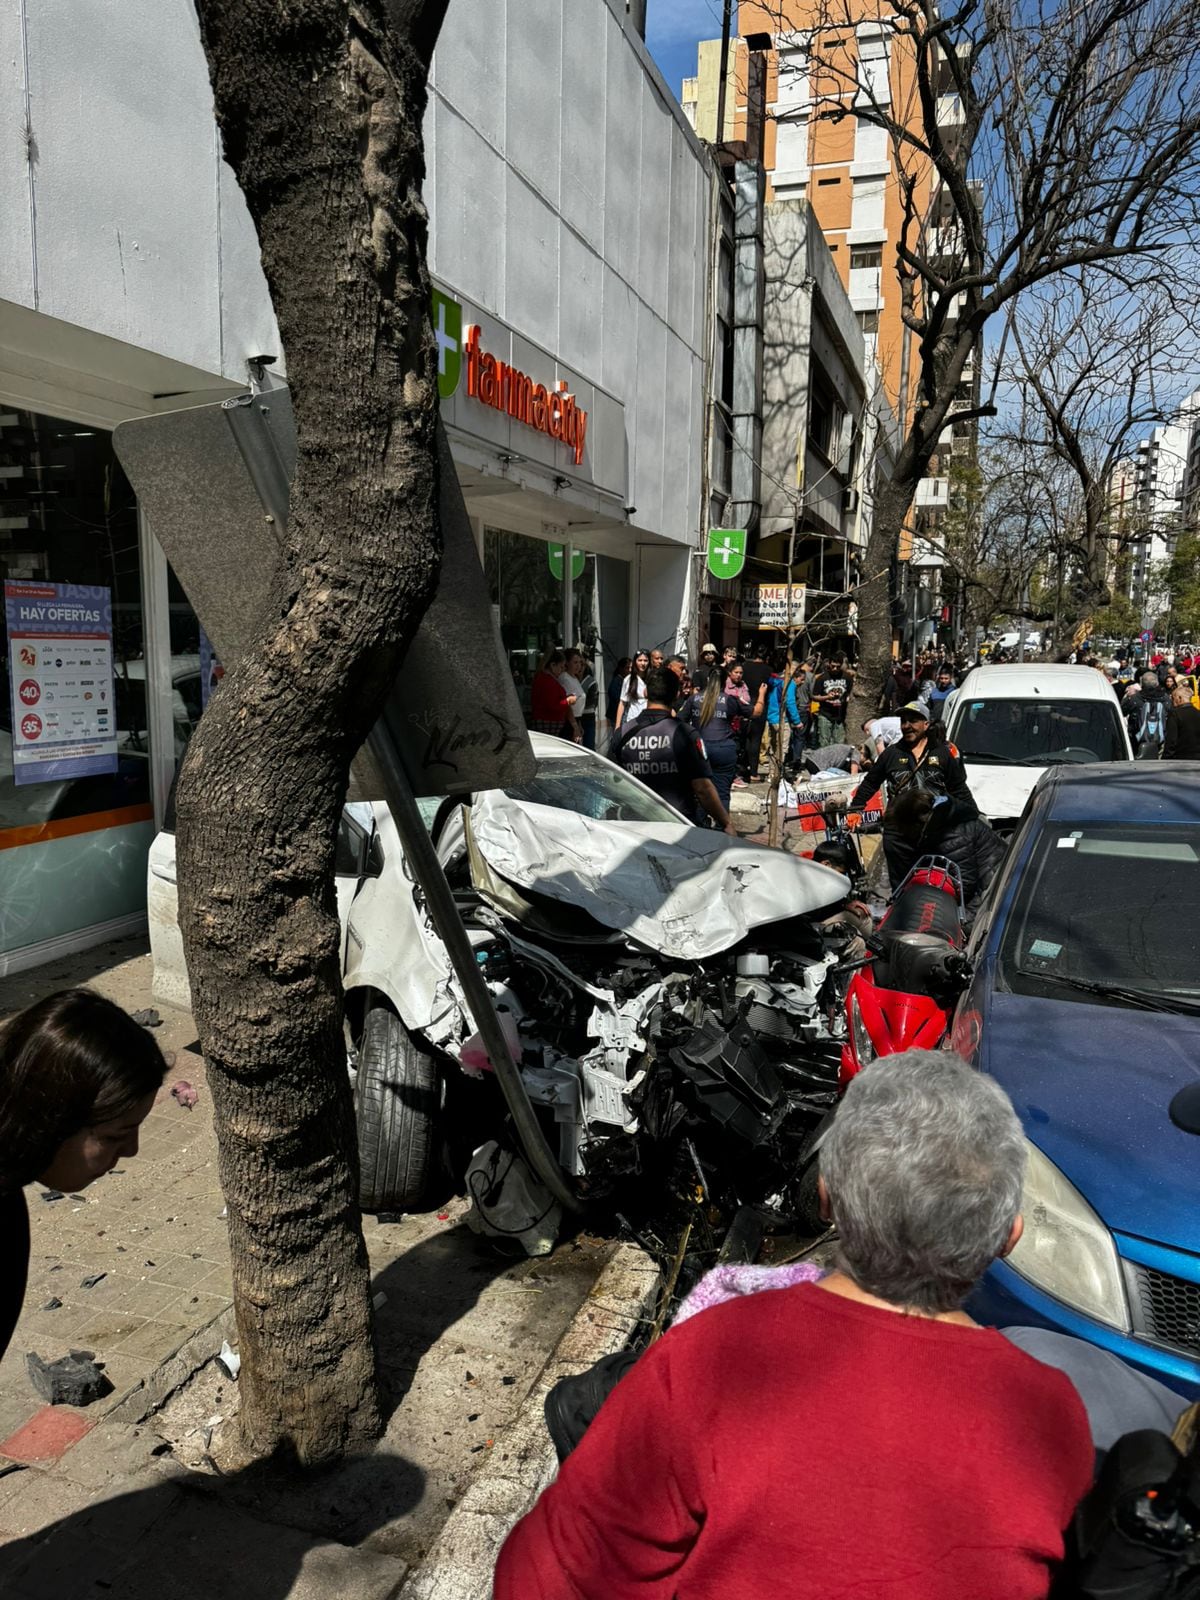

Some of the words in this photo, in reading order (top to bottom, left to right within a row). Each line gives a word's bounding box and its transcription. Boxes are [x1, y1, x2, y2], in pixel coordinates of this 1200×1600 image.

[465, 323, 588, 465] farmacity
[20, 606, 46, 620] HAY
[48, 608, 100, 622] OFERTAS
[748, 611, 796, 619] Empanads
[20, 648, 36, 666] 2x1
[691, 708, 727, 719] COBA
[638, 751, 651, 761] DE
